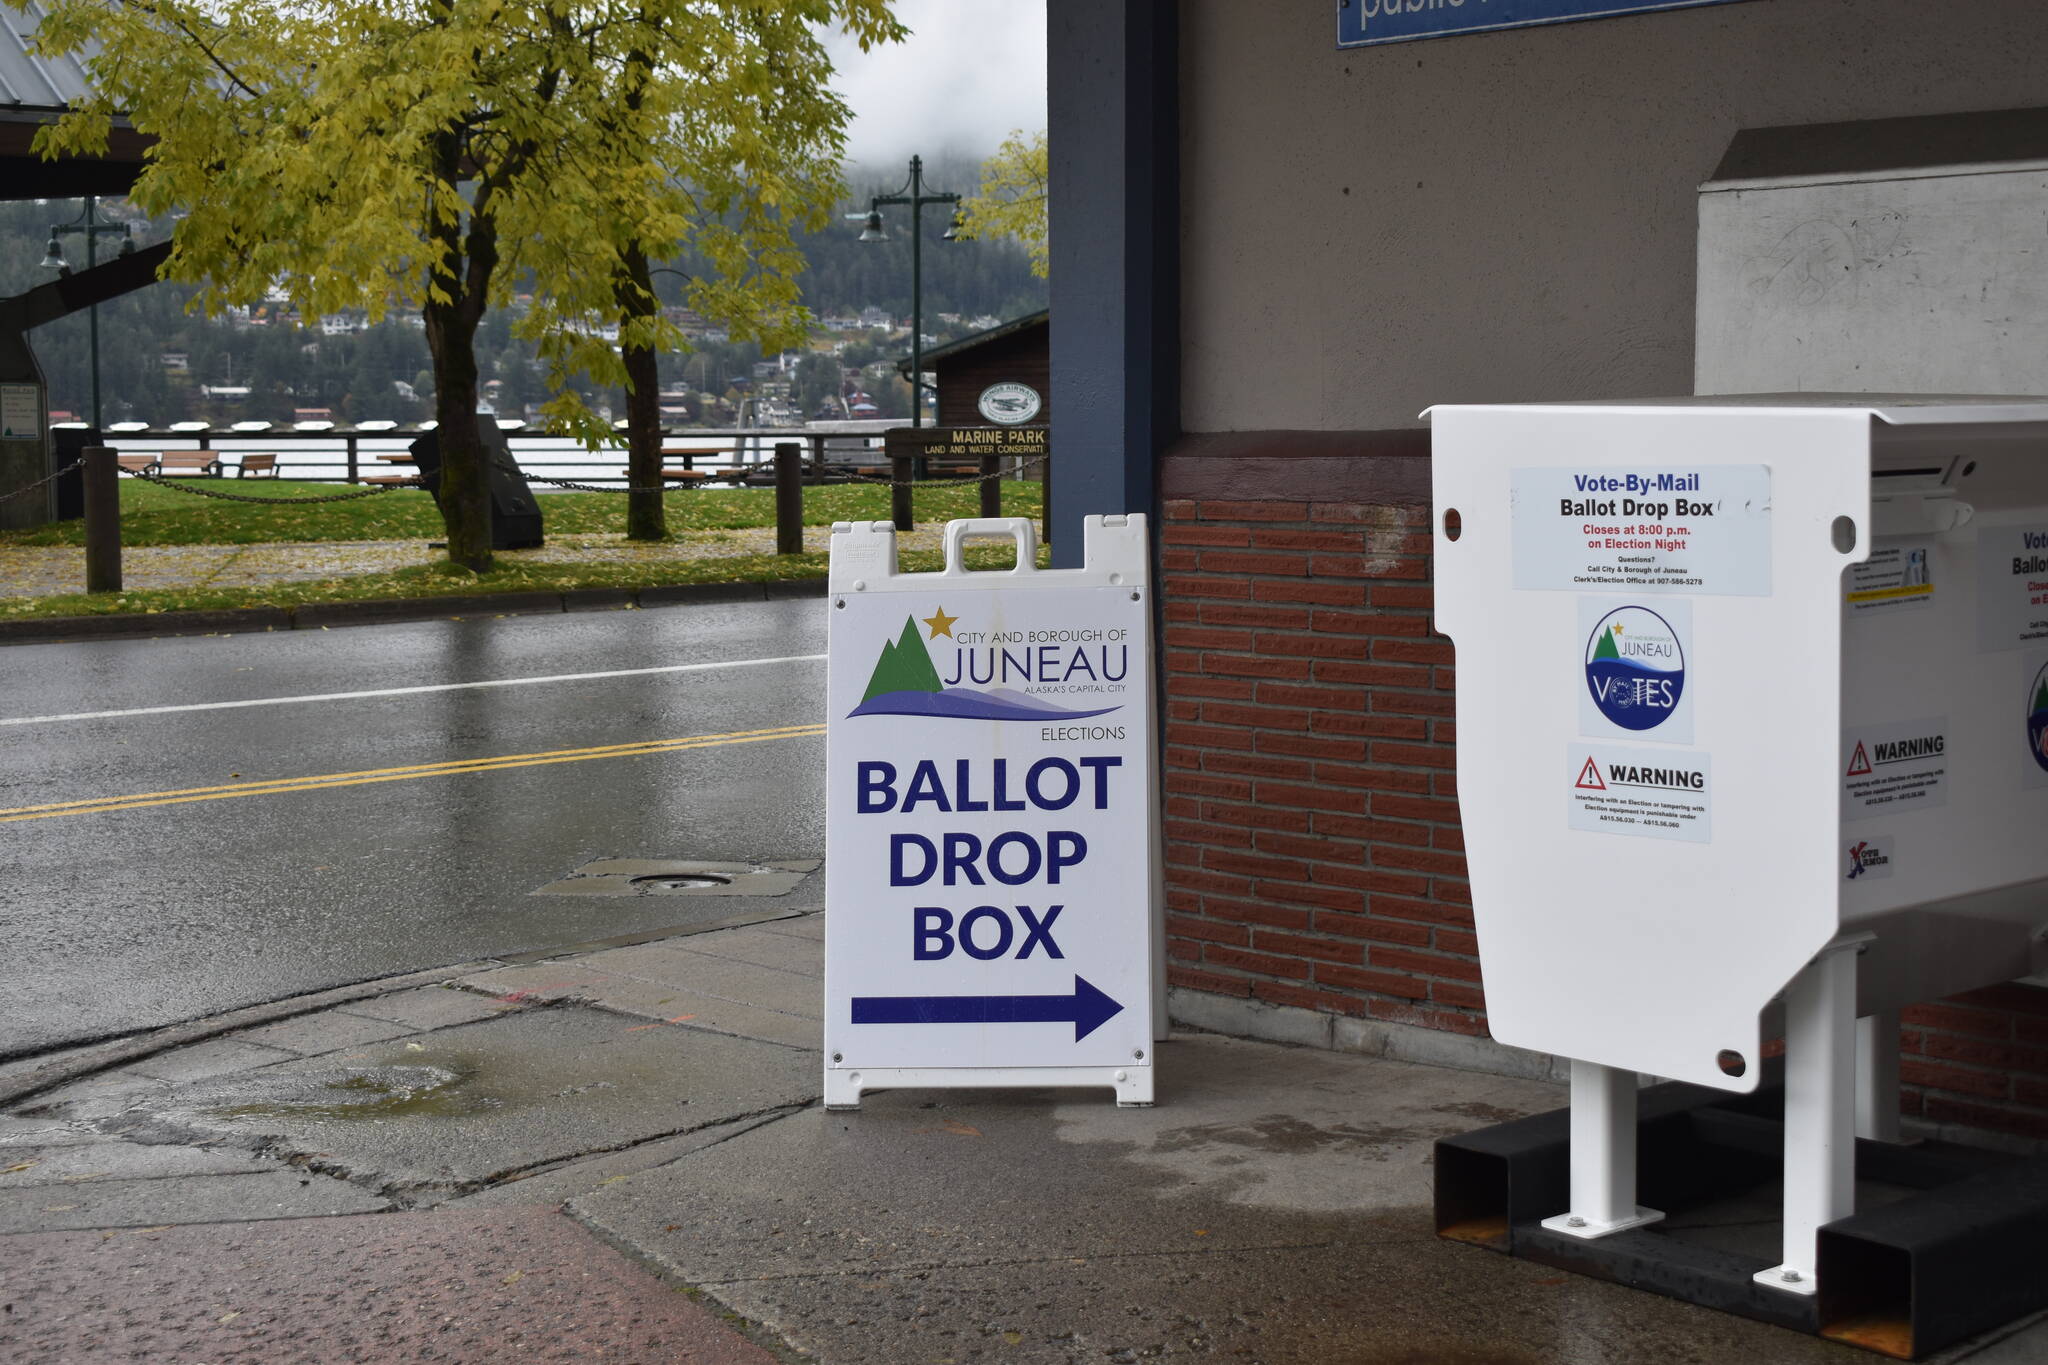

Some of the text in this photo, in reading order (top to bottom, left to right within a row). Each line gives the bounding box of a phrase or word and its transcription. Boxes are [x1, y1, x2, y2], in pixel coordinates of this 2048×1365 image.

[952, 430, 1045, 444] MARINE PARK
[924, 445, 945, 455] LAND
[949, 445, 966, 454] AND
[968, 444, 995, 454] WATER
[1574, 473, 1699, 496] Vote-By-Mail
[1560, 498, 1713, 520] Ballot Drop Box
[1583, 524, 1691, 537] Closes at 8:00 p.m.
[1588, 538, 1686, 552] on Election Night
[2023, 532, 2048, 549] Vot
[1587, 565, 1600, 573] Call
[1601, 565, 1615, 574] City
[1624, 566, 1652, 575] Borough
[957, 629, 1127, 645] CITY AND BOROUGH OF
[1621, 642, 1672, 658] JUNEAU
[944, 645, 1128, 686] JUNEAU
[1024, 684, 1127, 695] ALASKA'S CAPITAL CITY
[1041, 726, 1126, 741] ELECTIONS
[1874, 735, 1944, 761] WARNING
[1609, 764, 1704, 789] WARNING
[856, 756, 1123, 814] BALLOT
[1575, 794, 1604, 803] Interfering
[1628, 799, 1652, 807] Election
[1661, 803, 1690, 812] tampering
[1609, 807, 1639, 815] equipment
[889, 831, 1088, 887] DROP
[913, 905, 1065, 961] BOX
